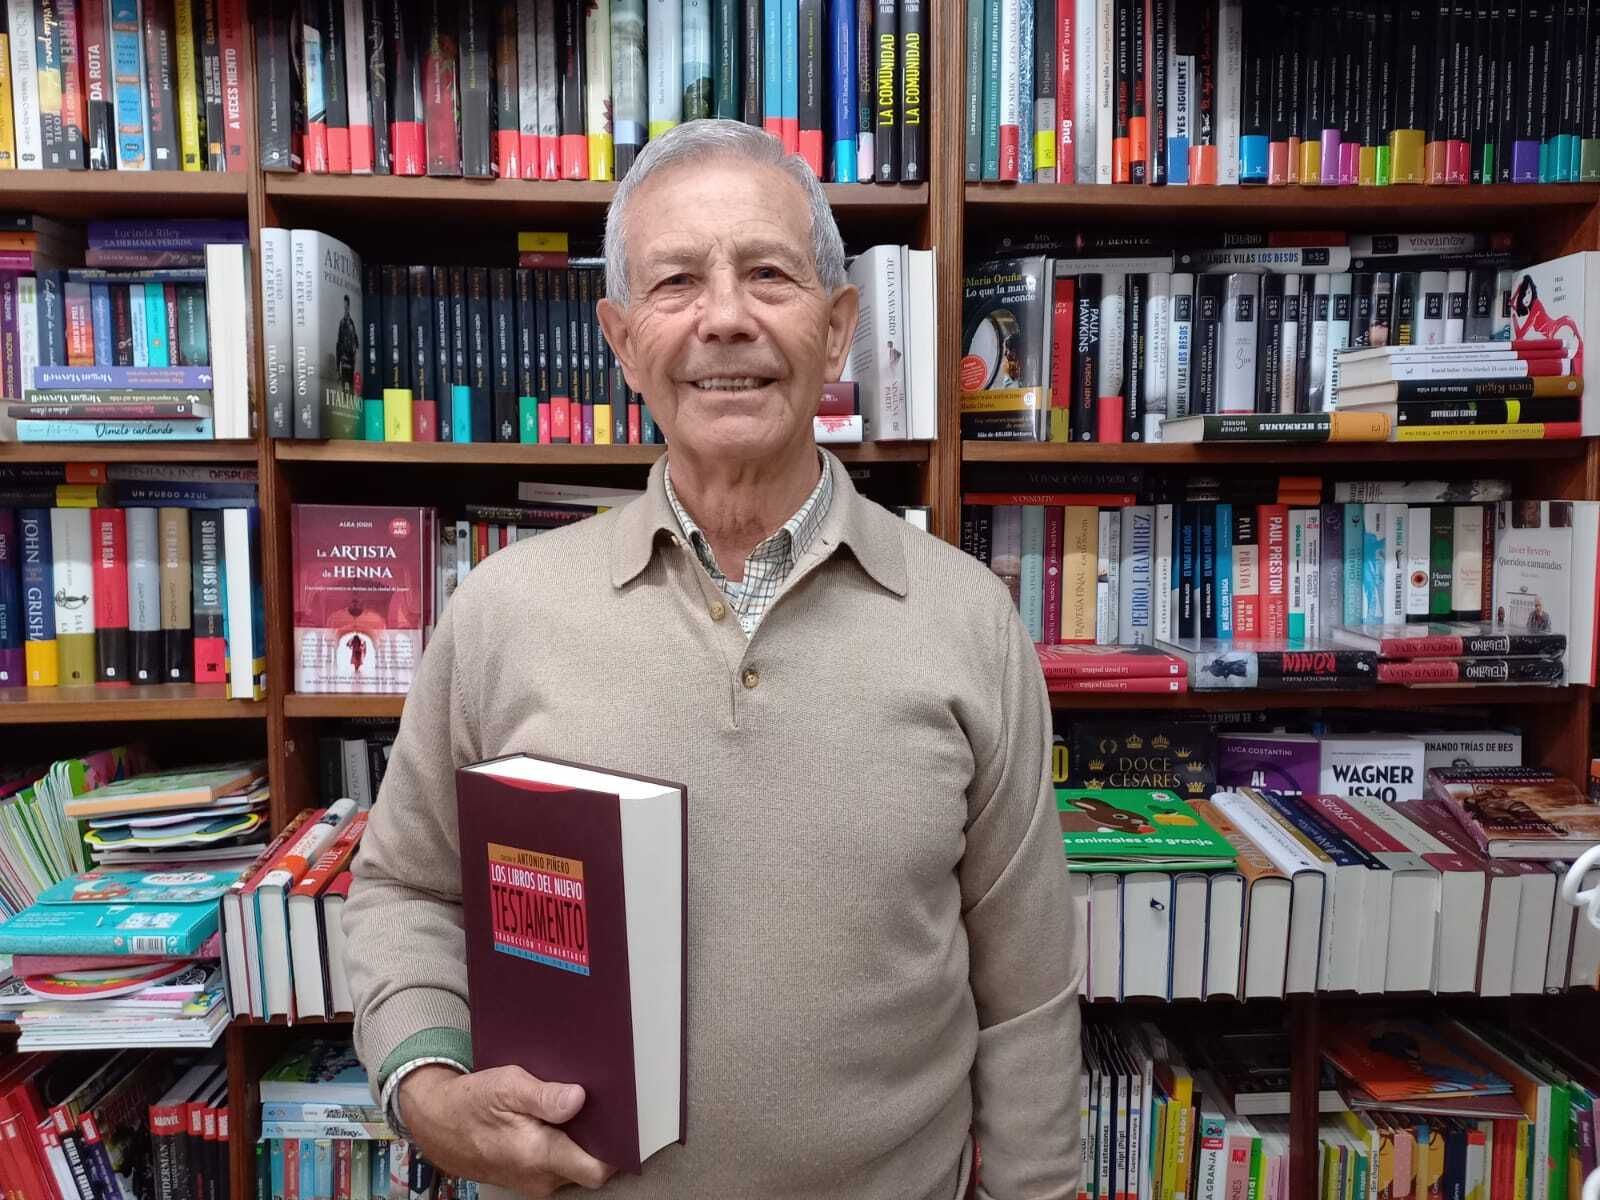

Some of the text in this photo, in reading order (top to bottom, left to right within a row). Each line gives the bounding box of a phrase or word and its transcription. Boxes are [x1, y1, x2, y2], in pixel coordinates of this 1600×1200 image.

[88, 44, 101, 76] ROTA
[225, 48, 238, 85] MIENTO
[879, 34, 895, 125] LA COMUNIDAD
[906, 33, 920, 124] LA COMUNIDAD
[1177, 61, 1186, 112] SIGUIENTE
[227, 88, 240, 120] VECES
[1409, 236, 1465, 247] AQUITANIA
[966, 274, 1022, 288] María Oruña
[966, 288, 976, 297] Lo
[979, 287, 994, 297] que
[997, 285, 1005, 294] la
[1002, 292, 1036, 303] esconde
[1079, 299, 1089, 353] HAWKINS
[1089, 308, 1099, 343] PAULA
[1178, 326, 1188, 349] BESOS
[268, 345, 276, 394] ITALIANO
[1178, 352, 1188, 365] LOS
[43, 373, 112, 382] Megan Maxwell
[297, 346, 306, 396] ITALIANO
[1178, 367, 1188, 389] VILAS
[32, 393, 101, 403] Megan Maxwell
[1259, 422, 1314, 431] HERMANAS
[132, 490, 208, 500] UN FUEGO AZUL
[22, 519, 40, 562] JOHN
[200, 520, 217, 606] LOS SONÁMBULOS
[316, 545, 396, 560] La ARTISTA
[1239, 518, 1250, 589] PAUL PRESTON
[1269, 517, 1282, 594] PAUL PRESTON
[334, 566, 392, 578] HENNA
[1131, 590, 1150, 626] PEDRO
[1227, 746, 1293, 757] LUCA COSTANTINI
[1459, 742, 1484, 752] TRÍAS
[1486, 744, 1497, 752] DE
[1498, 744, 1513, 752] BES
[1119, 757, 1171, 773] DOCE
[1333, 765, 1414, 784] WAGNER
[1251, 771, 1266, 787] AL
[1072, 837, 1141, 845] animales
[1145, 837, 1163, 845] de
[1166, 836, 1213, 846] granja
[517, 852, 545, 867] ANTONIO
[546, 857, 570, 874] PIÑERO
[491, 864, 582, 900] LOS LIBROS DEL NUEVO
[492, 885, 584, 951] TESTAMENTO
[495, 932, 587, 963] TRADUCCIÓN Y COMENTARIO
[1101, 1165, 1109, 1177] Las
[1206, 1151, 1216, 1192] GRANJA
